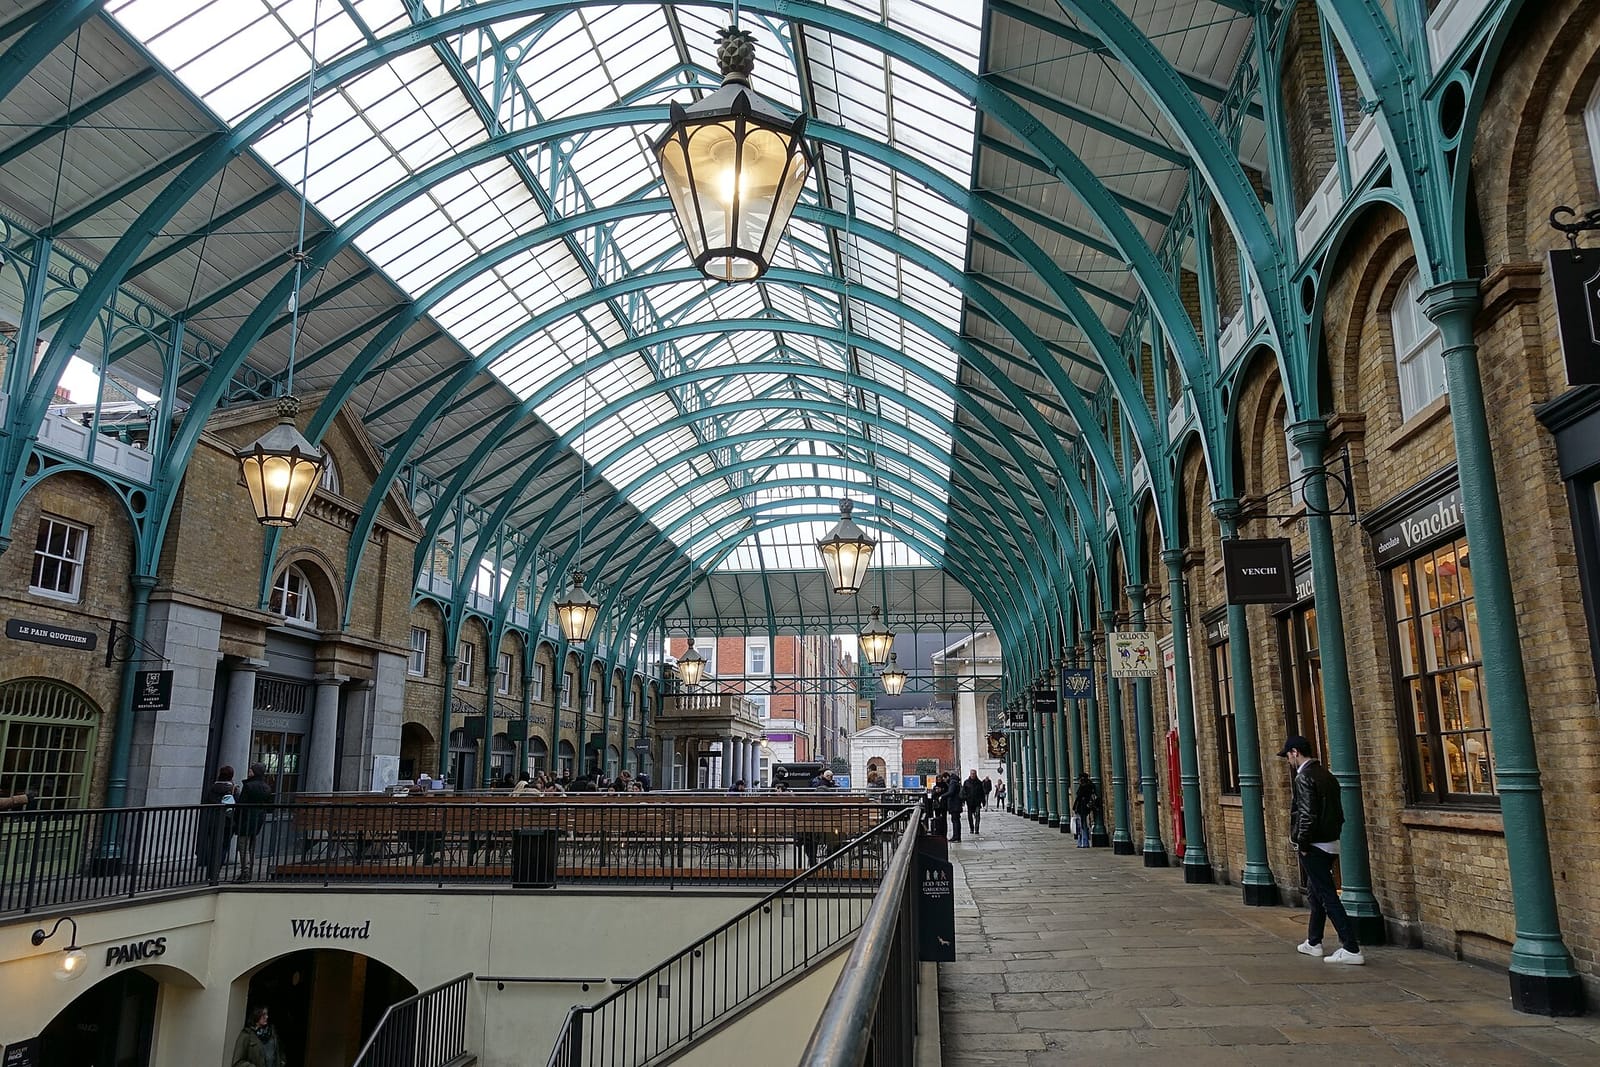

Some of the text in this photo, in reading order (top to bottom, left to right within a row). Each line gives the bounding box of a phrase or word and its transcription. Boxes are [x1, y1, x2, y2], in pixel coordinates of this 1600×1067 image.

[1400, 495, 1460, 548] Venchi
[1241, 567, 1277, 576] VENCHI
[18, 626, 88, 644] LE PAIN QUOTIDIEN
[290, 919, 370, 940] Whittard
[106, 936, 167, 968] PANCS
